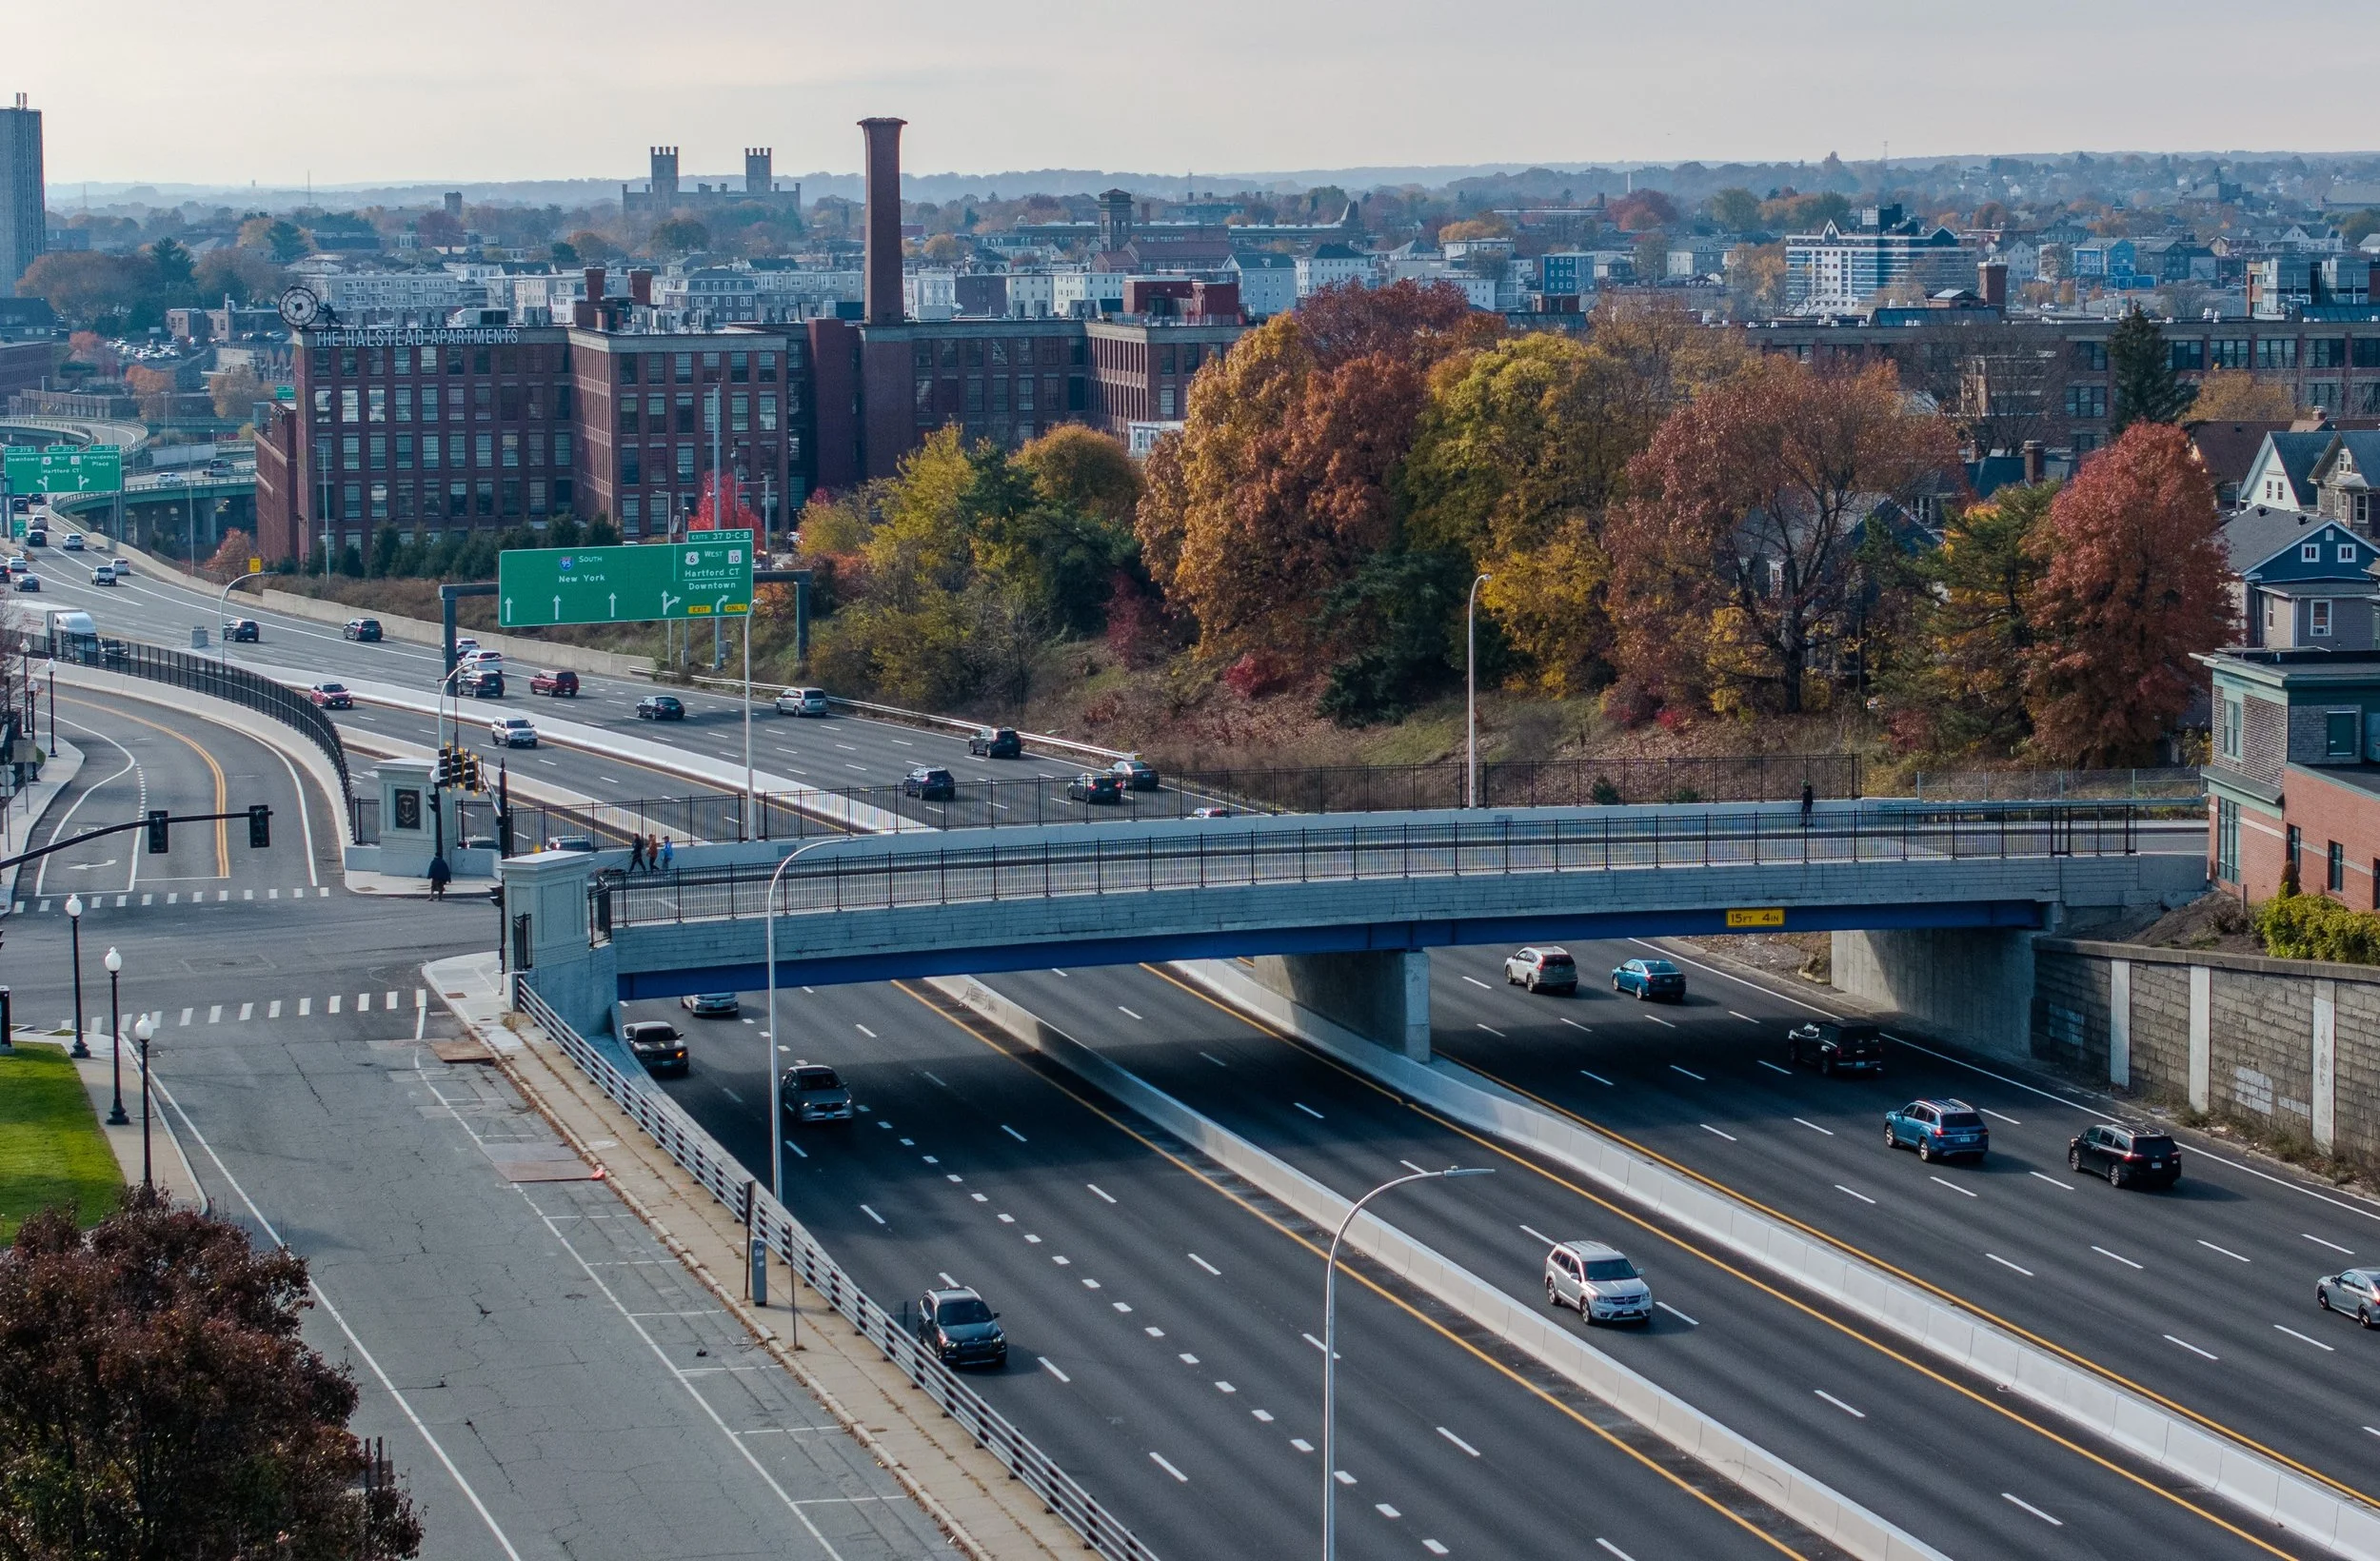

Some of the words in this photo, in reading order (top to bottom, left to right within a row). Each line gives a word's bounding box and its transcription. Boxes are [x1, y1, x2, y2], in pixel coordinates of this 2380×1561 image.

[314, 331, 340, 346] THE
[346, 329, 424, 346] HALSTEAD
[430, 328, 518, 344] APARTMENTS
[712, 532, 724, 541] 37
[725, 531, 749, 540] D-C-B
[689, 554, 696, 563] 6
[684, 568, 724, 578] Hartford
[729, 567, 740, 576] CT
[688, 582, 736, 590] Downtown
